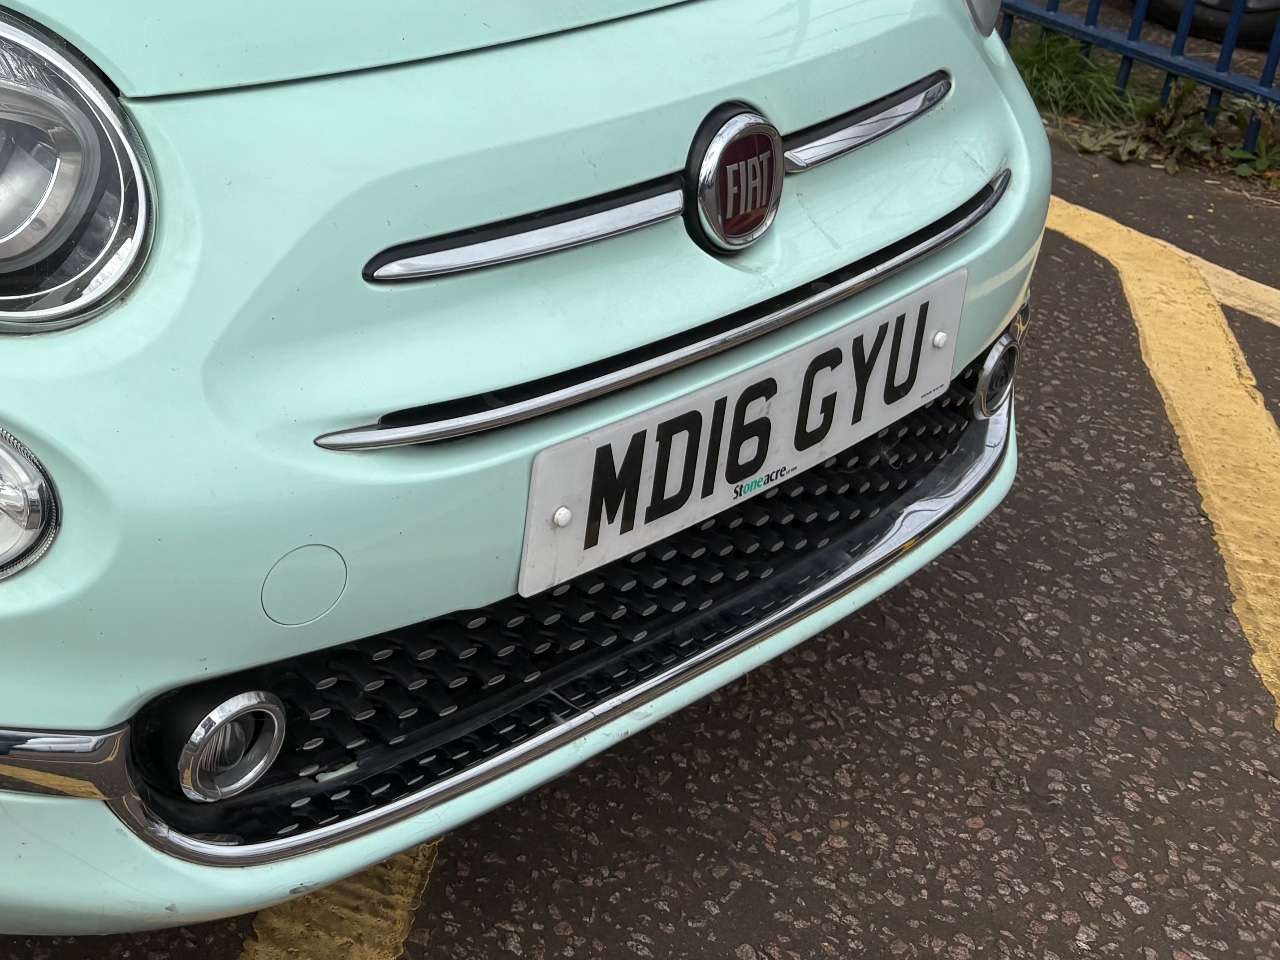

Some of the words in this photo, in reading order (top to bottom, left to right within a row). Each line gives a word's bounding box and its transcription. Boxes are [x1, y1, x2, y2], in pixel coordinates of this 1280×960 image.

[726, 150, 772, 220] FIAT
[583, 377, 779, 551] MD16
[793, 301, 930, 452] GYU
[732, 466, 787, 500] Stoneacre
